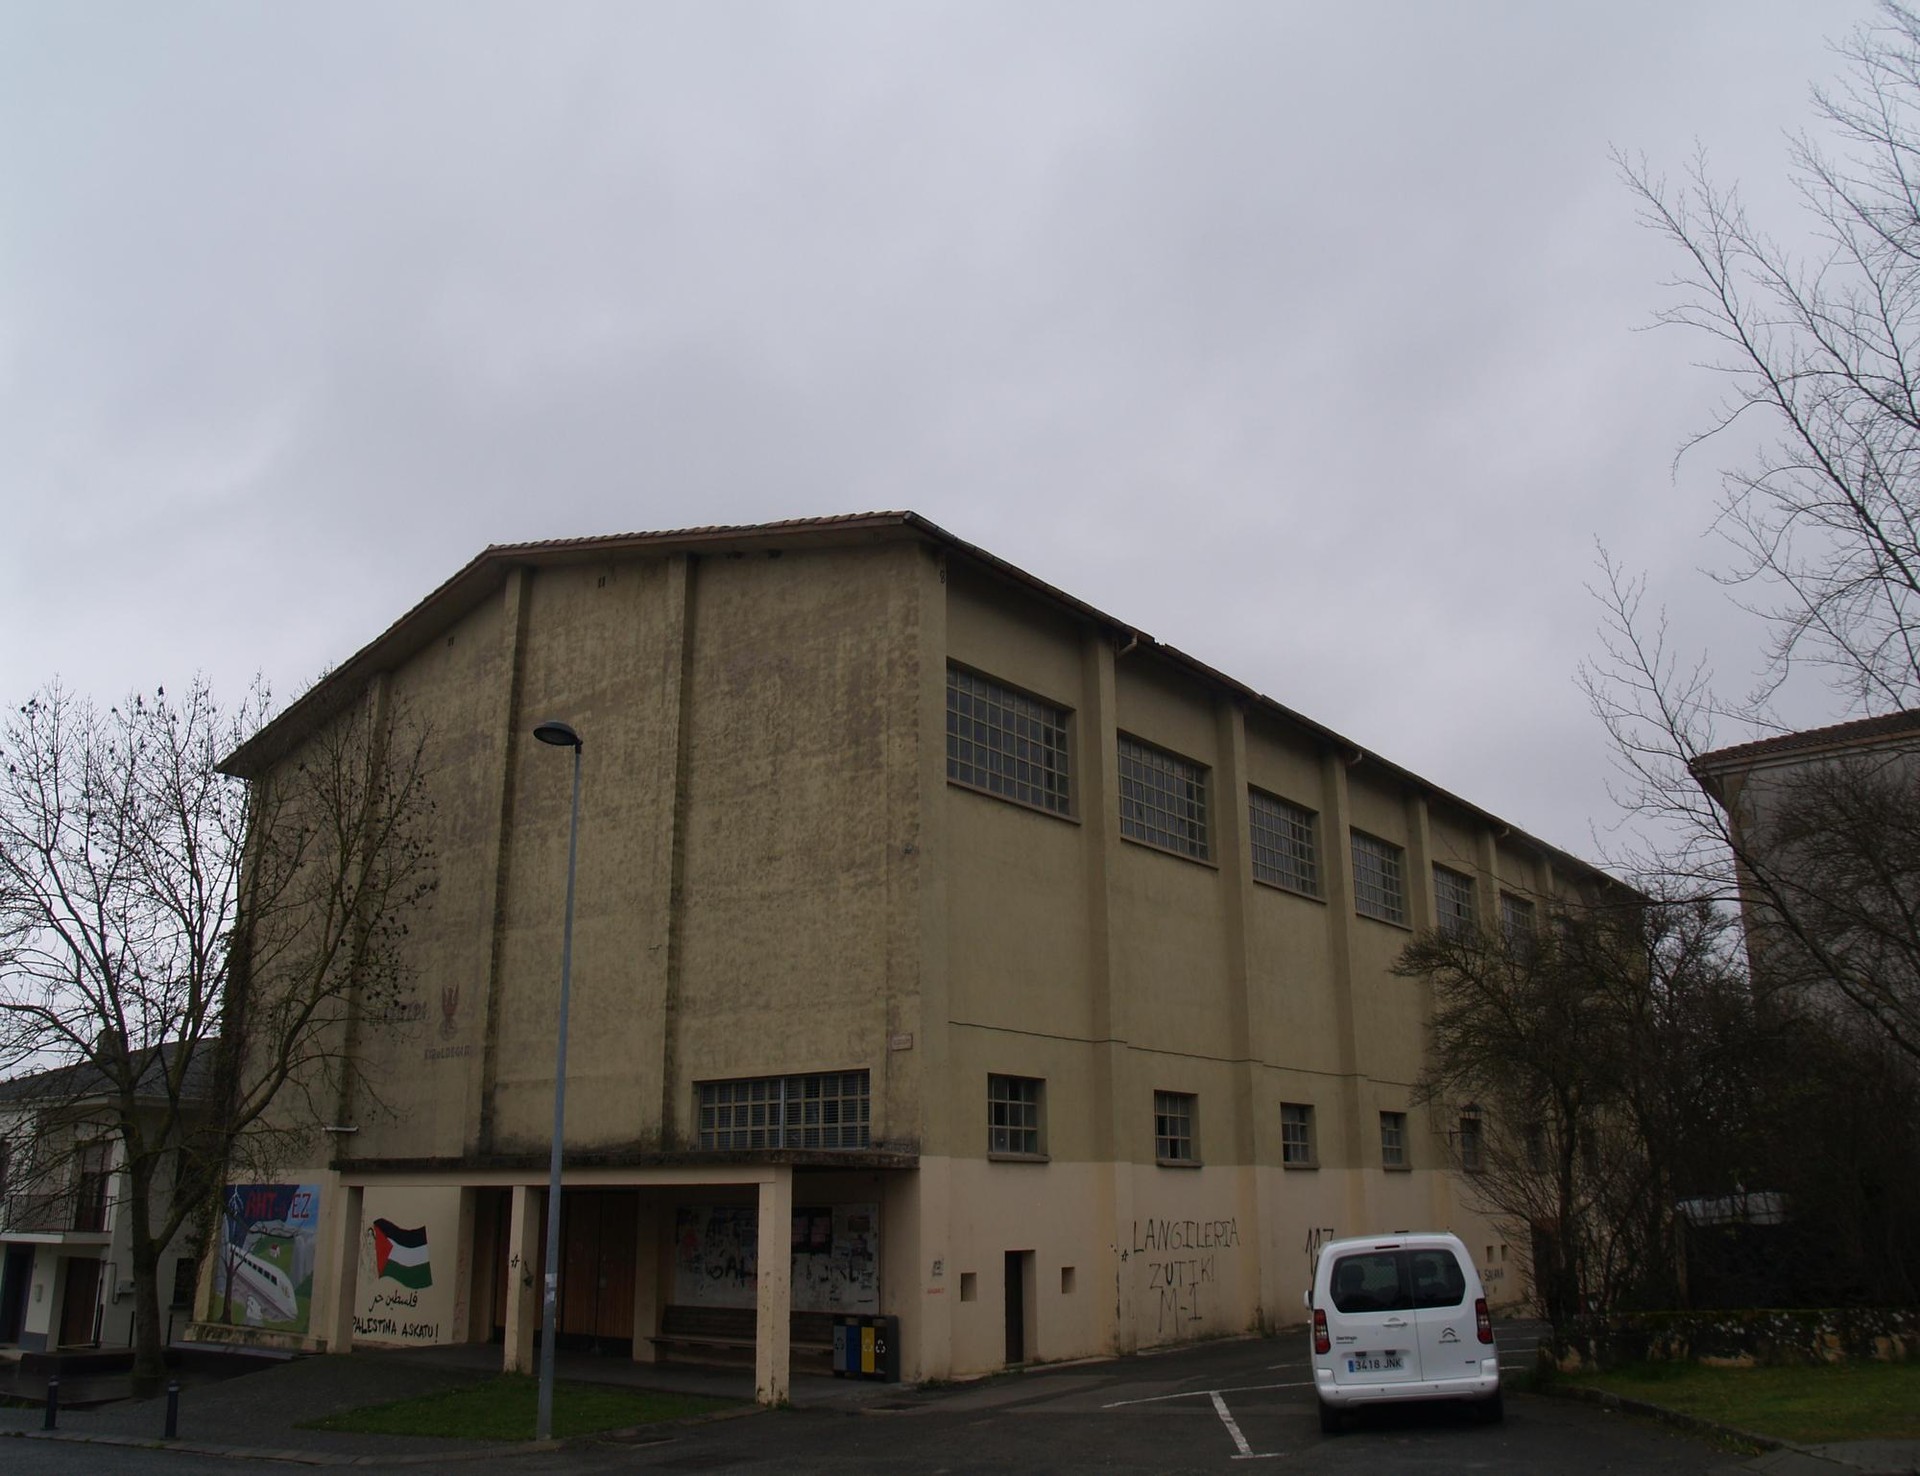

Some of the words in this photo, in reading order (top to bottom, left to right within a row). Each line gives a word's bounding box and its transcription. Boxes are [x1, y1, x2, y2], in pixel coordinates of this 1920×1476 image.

[291, 1193, 312, 1218] EZ
[1133, 1217, 1241, 1253] LANGILERIA
[1149, 1255, 1215, 1289] ZUTIK!
[402, 1323, 439, 1343] ASKATU!
[1355, 1359, 1380, 1370] 3418
